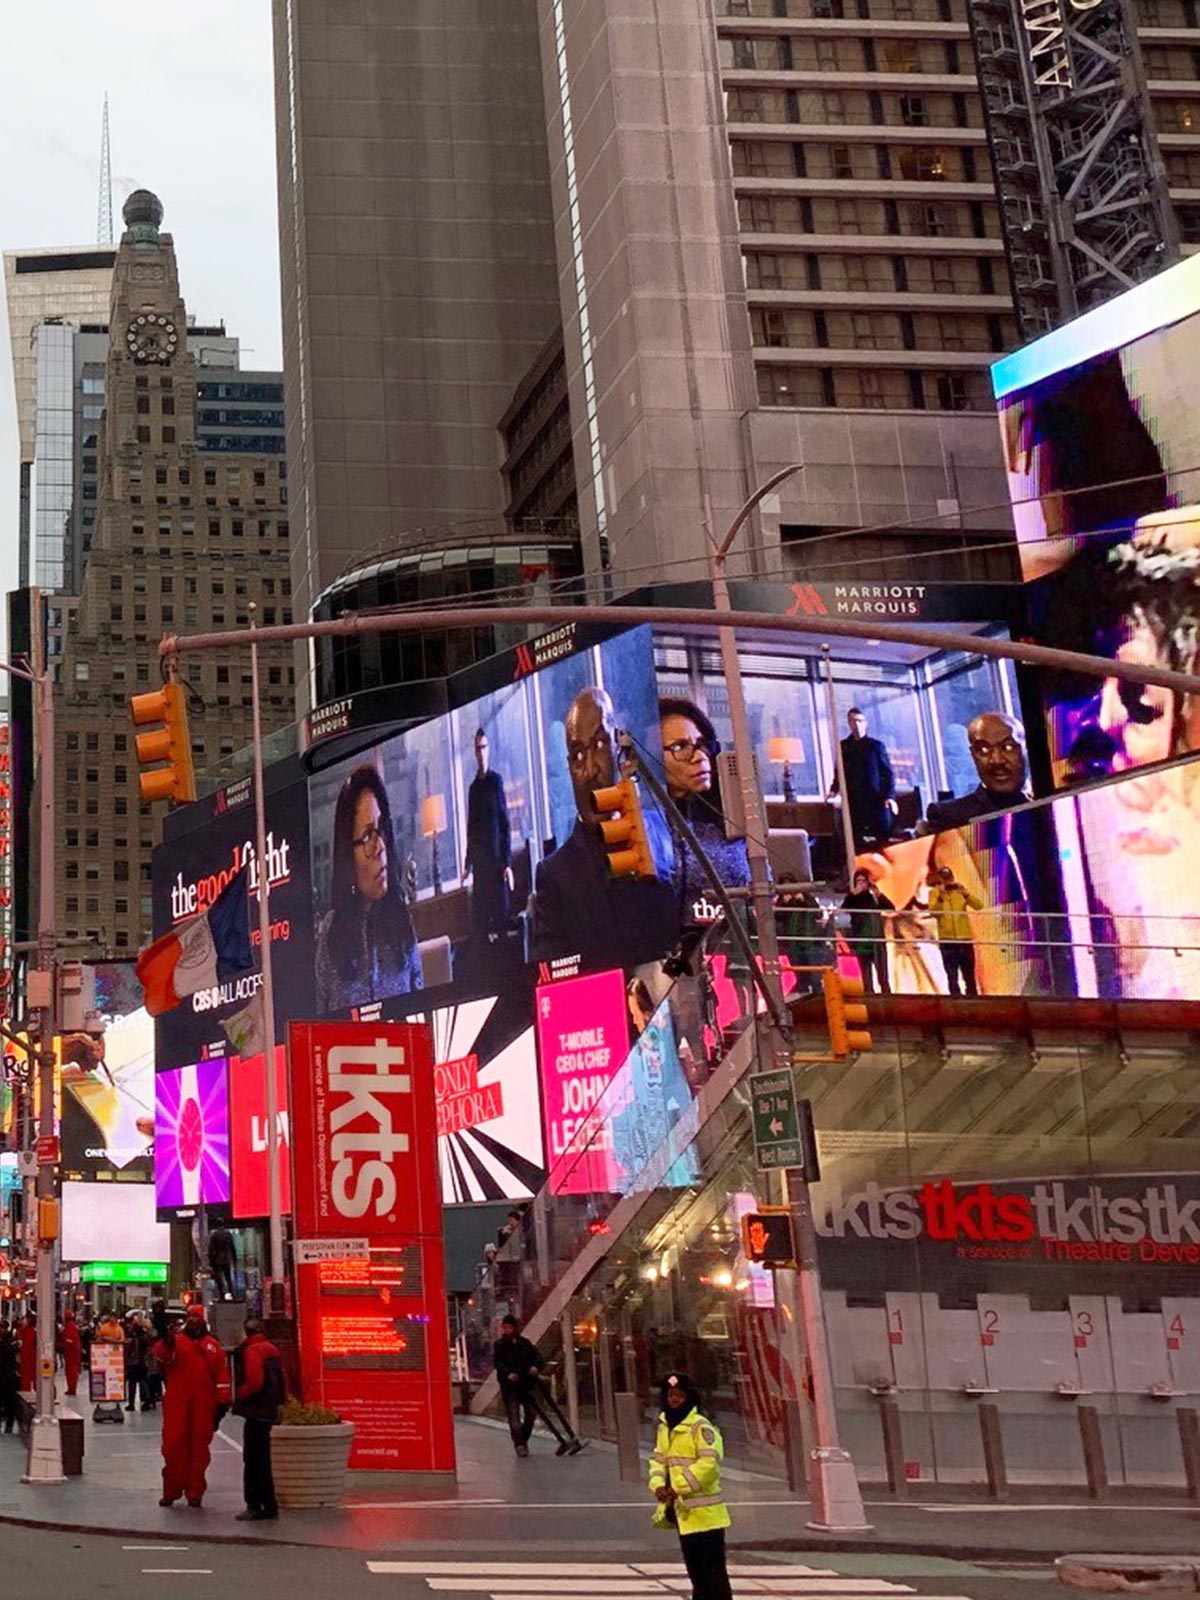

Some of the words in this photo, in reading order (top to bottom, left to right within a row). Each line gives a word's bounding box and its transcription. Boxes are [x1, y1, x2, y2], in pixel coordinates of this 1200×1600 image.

[835, 586, 926, 598] MARRIOTT
[837, 602, 918, 614] MARQUIS
[534, 622, 576, 651] MARRIOTT
[536, 639, 573, 666] MARQUIS
[558, 1027, 605, 1052] T-MOBILE
[313, 1053, 324, 1085] service
[556, 1054, 577, 1074] CEO
[577, 1052, 584, 1071] &
[584, 1048, 611, 1069] CHEF
[315, 1087, 325, 1096] of
[561, 1075, 611, 1115] JOHN
[316, 1098, 326, 1132] Theatre
[326, 1037, 411, 1219] tkts
[317, 1134, 328, 1192] Development
[319, 1194, 329, 1217] Fund
[809, 1181, 923, 1240] tkts
[919, 1178, 1036, 1242] tkts
[1028, 1181, 1147, 1244] tkts
[968, 1247, 1020, 1259] service
[1041, 1236, 1133, 1262] Theatre
[1138, 1237, 1200, 1263] Deve
[893, 1309, 903, 1331] 1
[984, 1310, 999, 1333] 2
[1077, 1311, 1094, 1336] 3
[1169, 1313, 1186, 1337] 4
